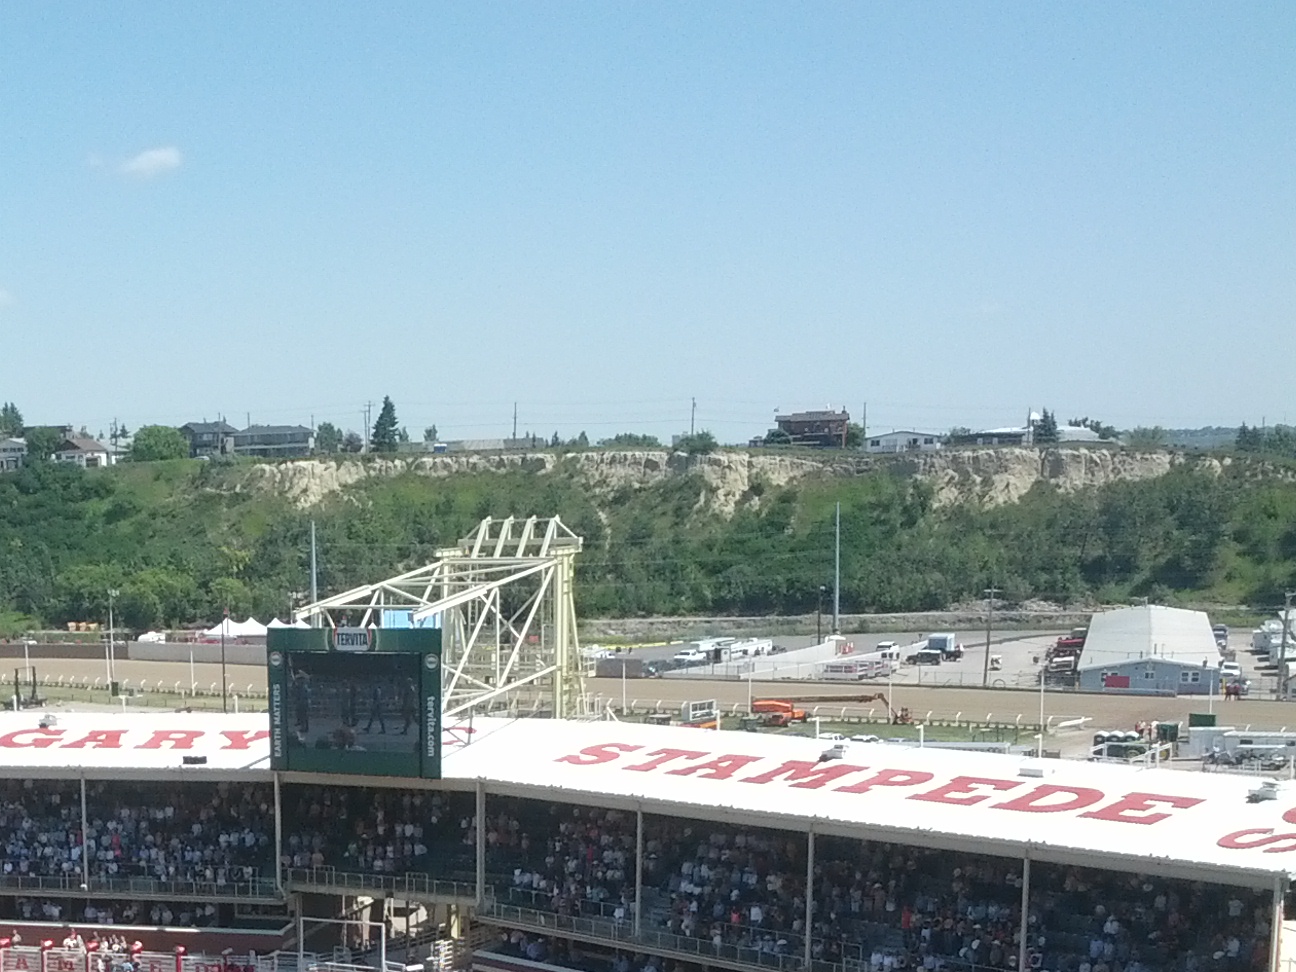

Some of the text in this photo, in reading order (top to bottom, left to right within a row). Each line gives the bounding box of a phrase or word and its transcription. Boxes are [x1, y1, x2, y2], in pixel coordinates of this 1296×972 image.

[336, 632, 368, 646] TERVITA
[272, 684, 282, 757] EARTH MATTERS
[426, 696, 436, 757] tervita.com
[553, 743, 1207, 825] STAMPEDE
